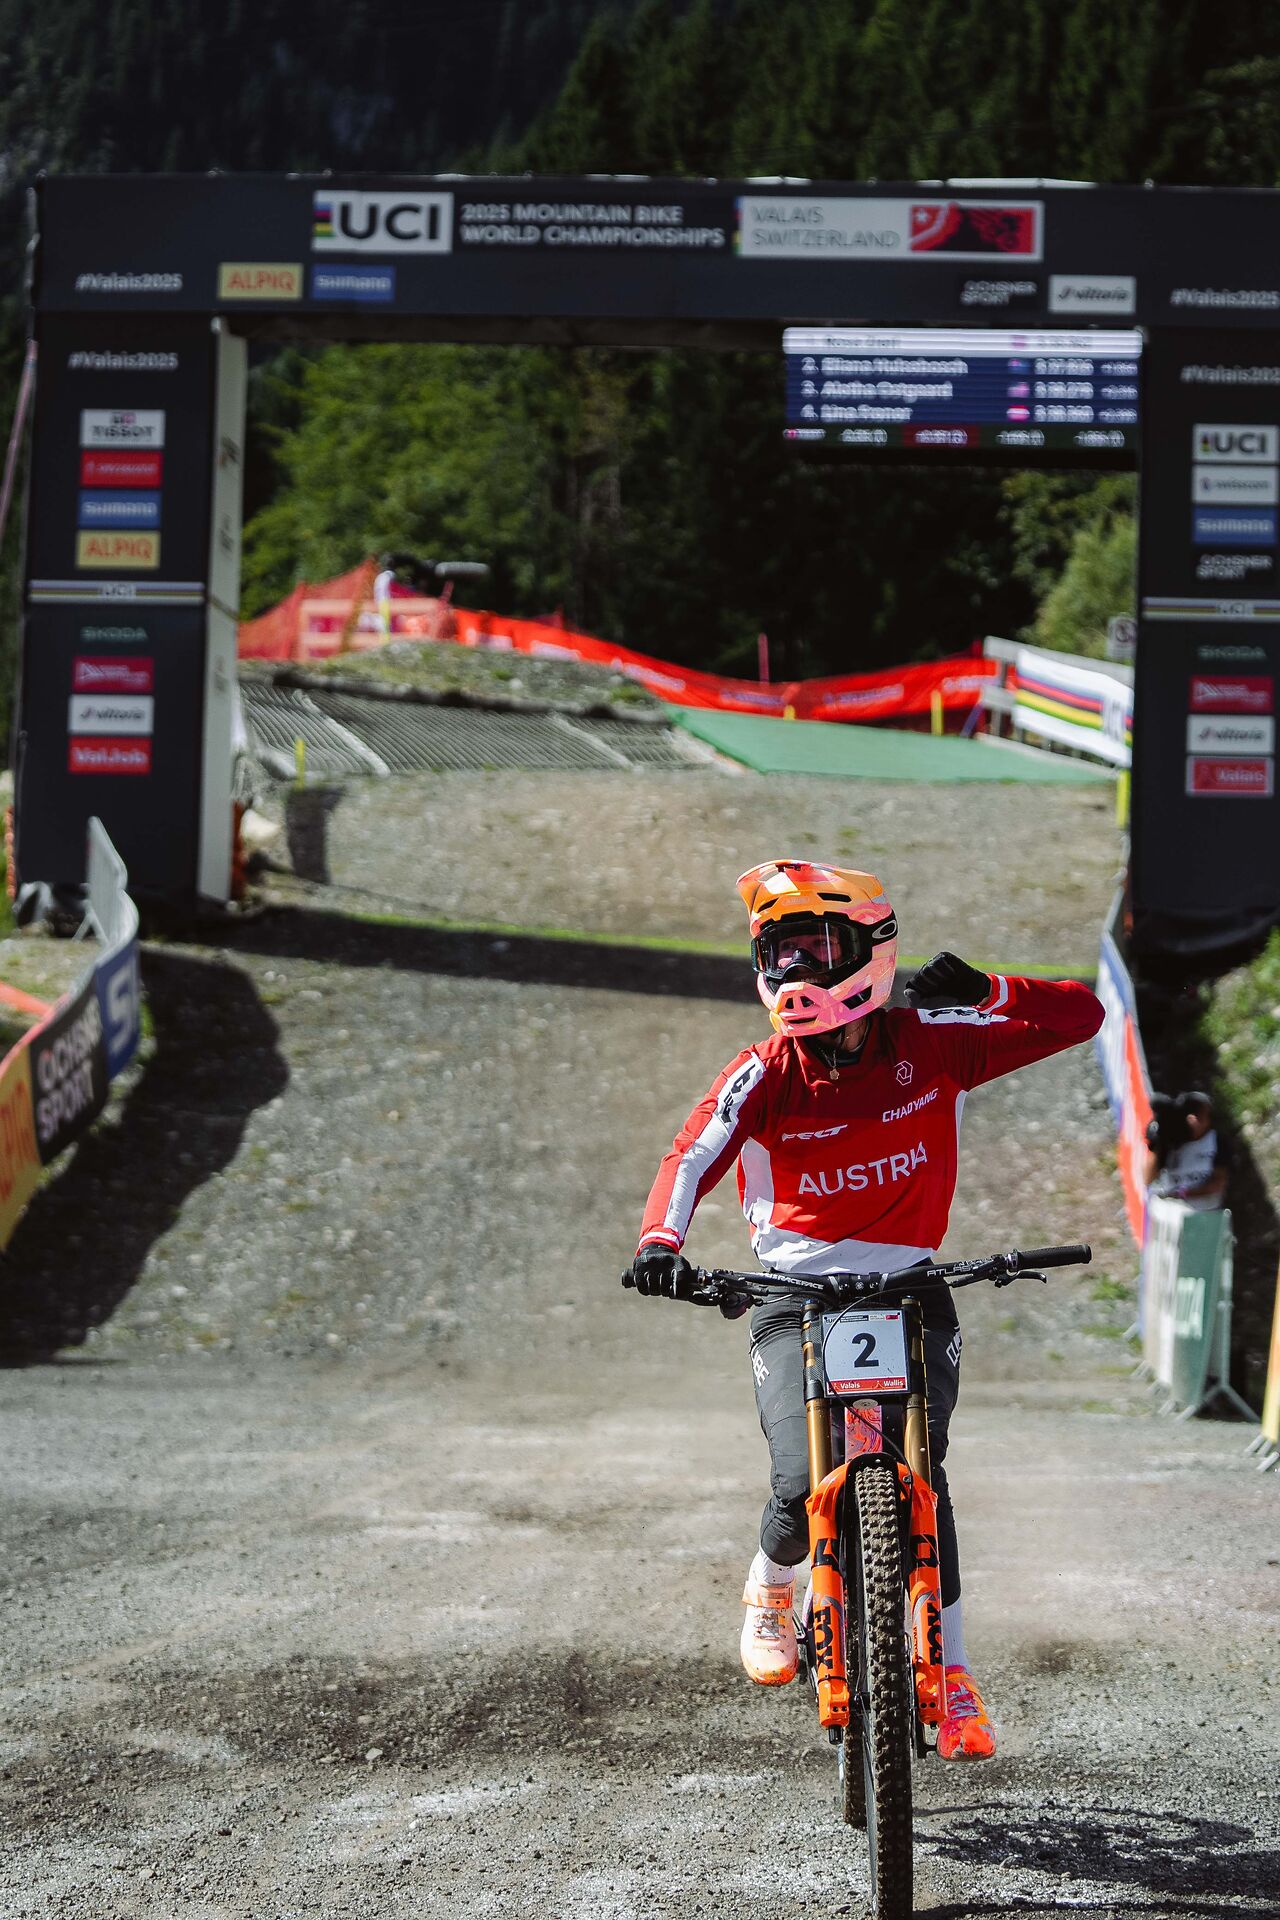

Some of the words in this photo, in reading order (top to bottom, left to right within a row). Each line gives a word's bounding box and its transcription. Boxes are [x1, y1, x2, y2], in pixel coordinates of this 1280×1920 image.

[340, 203, 441, 241] UCI
[461, 203, 511, 222] 2025
[513, 204, 632, 223] MOUNTAIN
[634, 205, 684, 224] BIKE
[753, 206, 824, 224] VALAIS
[461, 225, 541, 245] WORLD
[546, 226, 725, 248] CHAMPIONSHIPS
[753, 229, 900, 249] SWITZERLAND
[75, 273, 184, 292] #Valais2025
[227, 270, 295, 292] ALPIQ
[67, 351, 179, 370] #Valais2025
[1181, 365, 1280, 384] #Valais202
[1214, 433, 1269, 454] UCI
[85, 538, 154, 559] ALPIQ
[36, 1059, 95, 1143] SPORT
[882, 1088, 939, 1123] CHAOYANG
[798, 1141, 929, 1198] AUSTRIA
[927, 1265, 971, 1278] ATLAS
[851, 1332, 880, 1369] 2
[840, 1380, 861, 1390] Valais
[883, 1377, 904, 1388] Wallis
[815, 1606, 834, 1670] FOX
